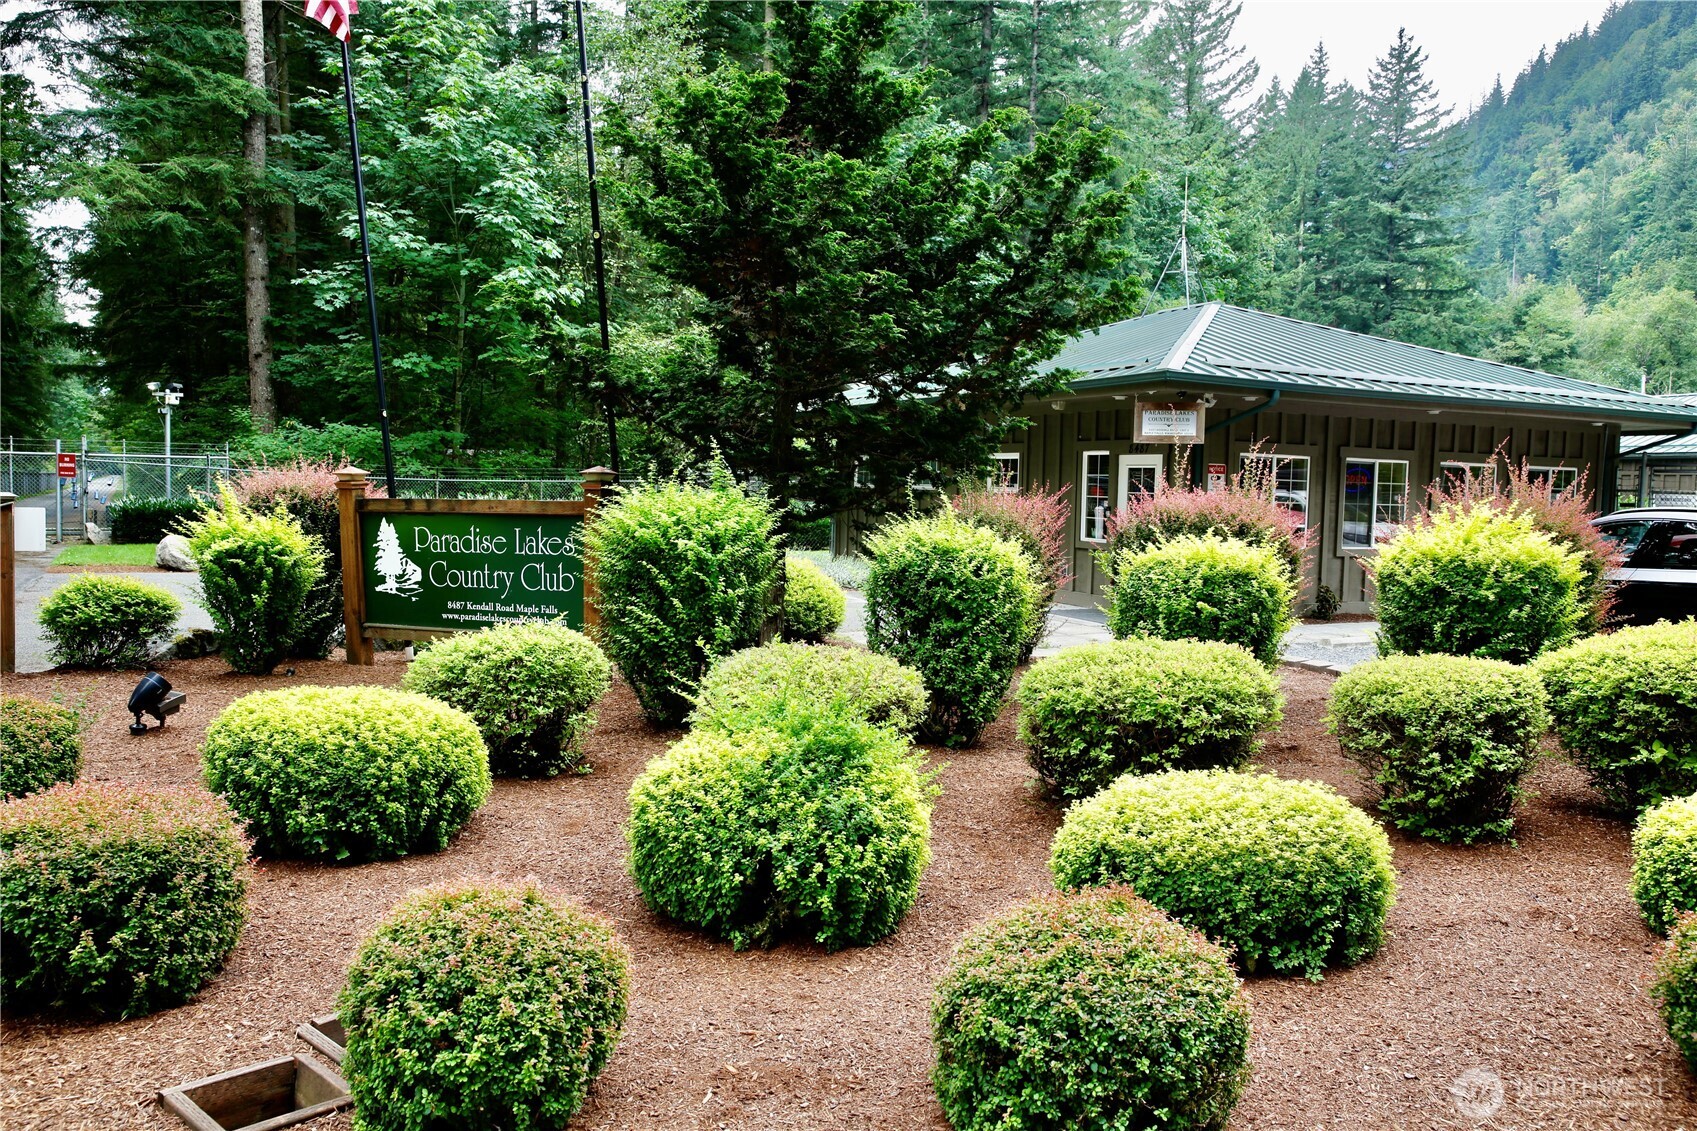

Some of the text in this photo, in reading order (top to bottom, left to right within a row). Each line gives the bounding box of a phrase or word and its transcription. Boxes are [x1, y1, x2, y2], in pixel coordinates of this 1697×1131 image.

[413, 525, 576, 556] Paradise Lakes
[429, 560, 576, 599] Country Club
[447, 601, 558, 614] 8487 Kendall Road Maple Falls
